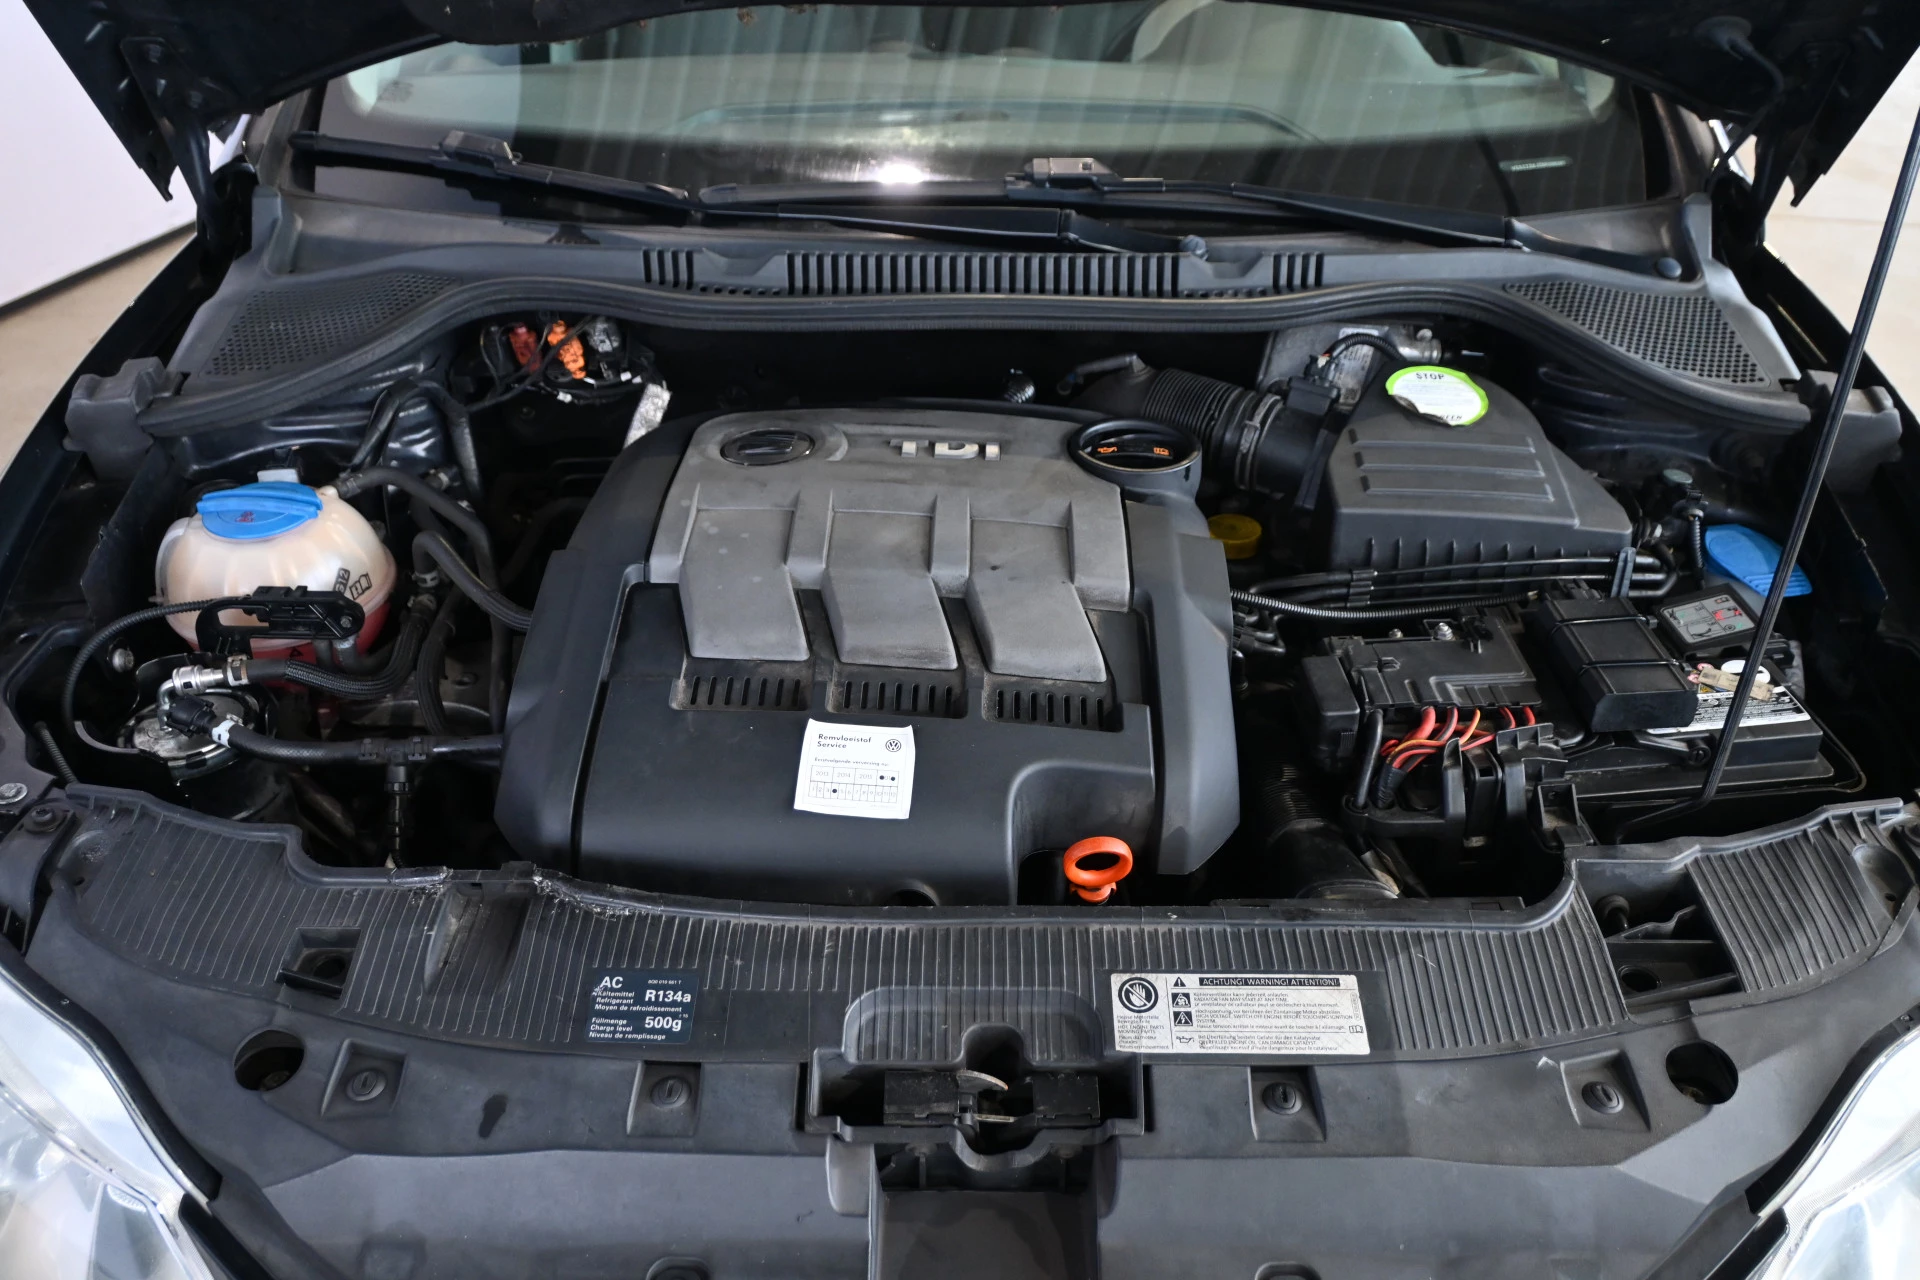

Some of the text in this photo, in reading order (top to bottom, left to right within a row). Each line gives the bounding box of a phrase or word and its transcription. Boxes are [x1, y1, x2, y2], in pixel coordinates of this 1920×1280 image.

[890, 439, 1000, 460] TDI
[818, 734, 872, 743] Remvloeistof
[600, 976, 623, 988] AC
[645, 989, 691, 1002] R134a
[592, 1017, 627, 1025] Füllmenge
[644, 1016, 682, 1032] 500g
[590, 1024, 614, 1032] Charge
